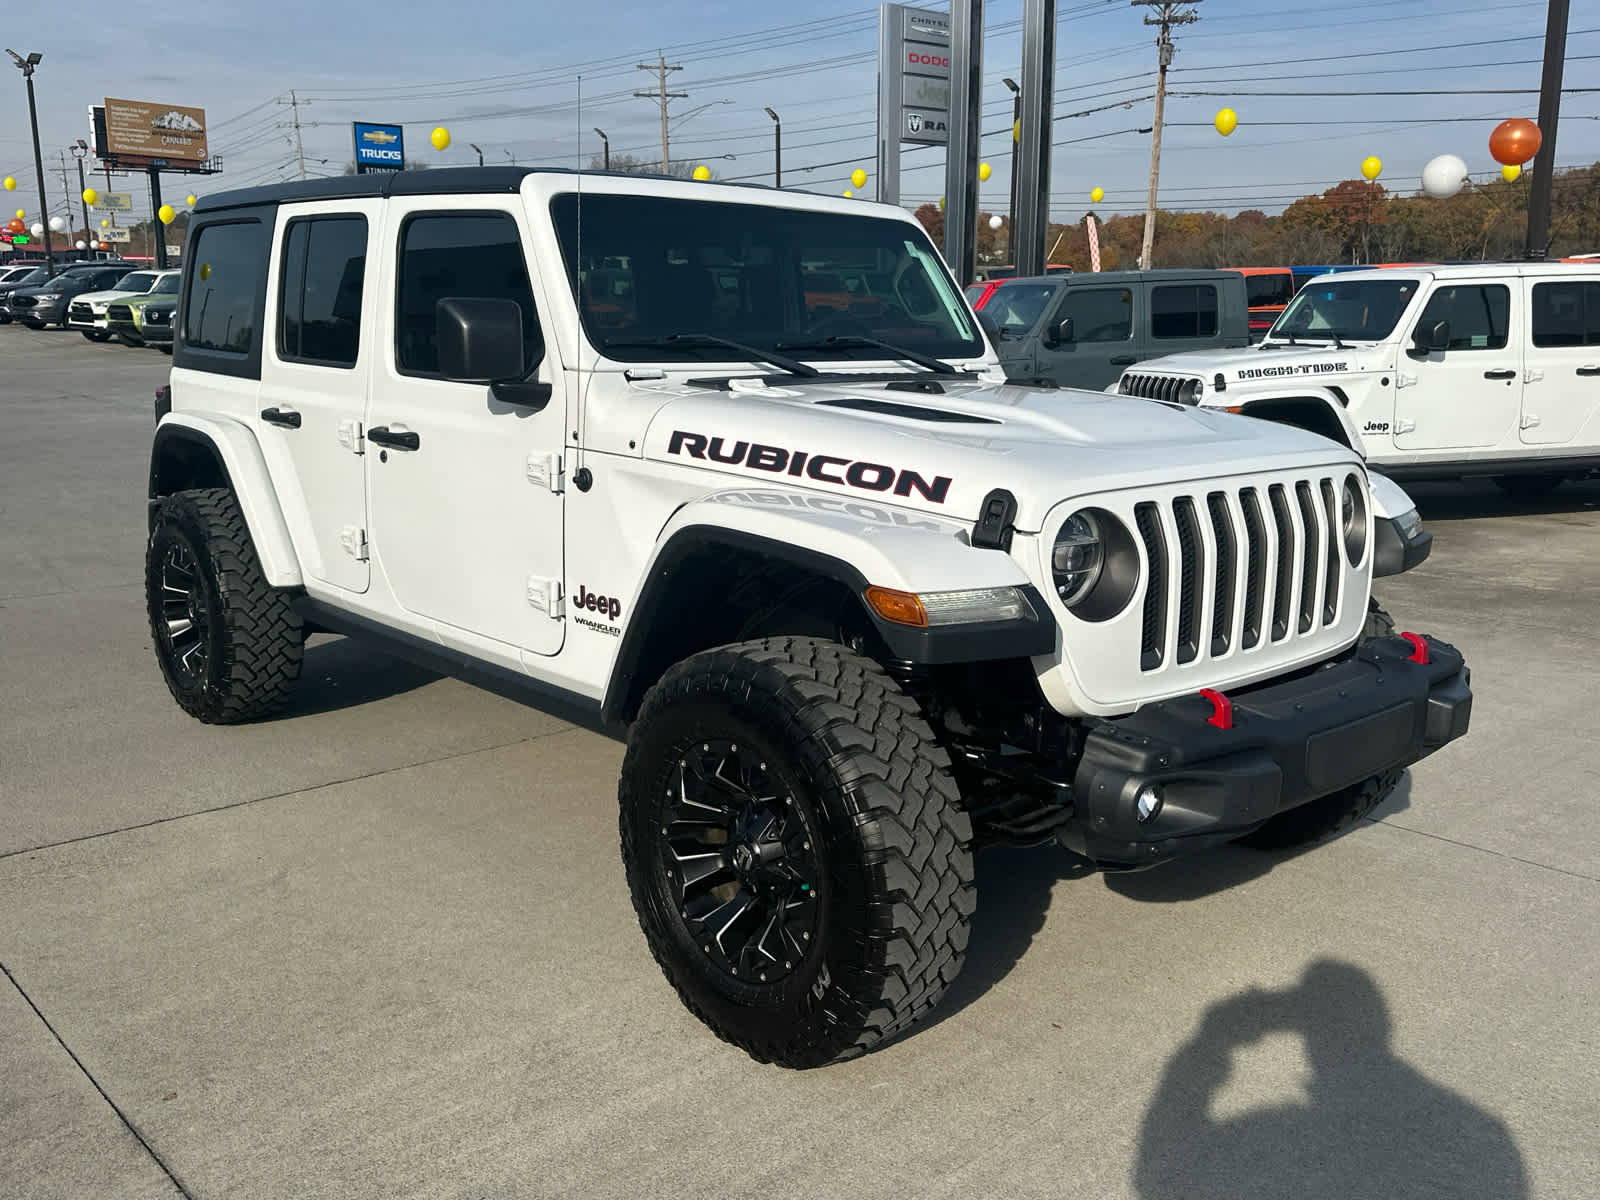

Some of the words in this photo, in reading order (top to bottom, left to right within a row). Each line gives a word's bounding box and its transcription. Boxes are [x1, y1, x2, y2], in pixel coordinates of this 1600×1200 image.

[911, 16, 949, 27] CHRYSL
[908, 52, 949, 68] DODG
[924, 120, 946, 131] RA
[360, 148, 401, 160] TRUCKS
[1364, 420, 1389, 432] Jeep
[667, 429, 953, 504] RUBICON
[573, 584, 621, 622] Jeep
[574, 615, 621, 634] WRANGLER
